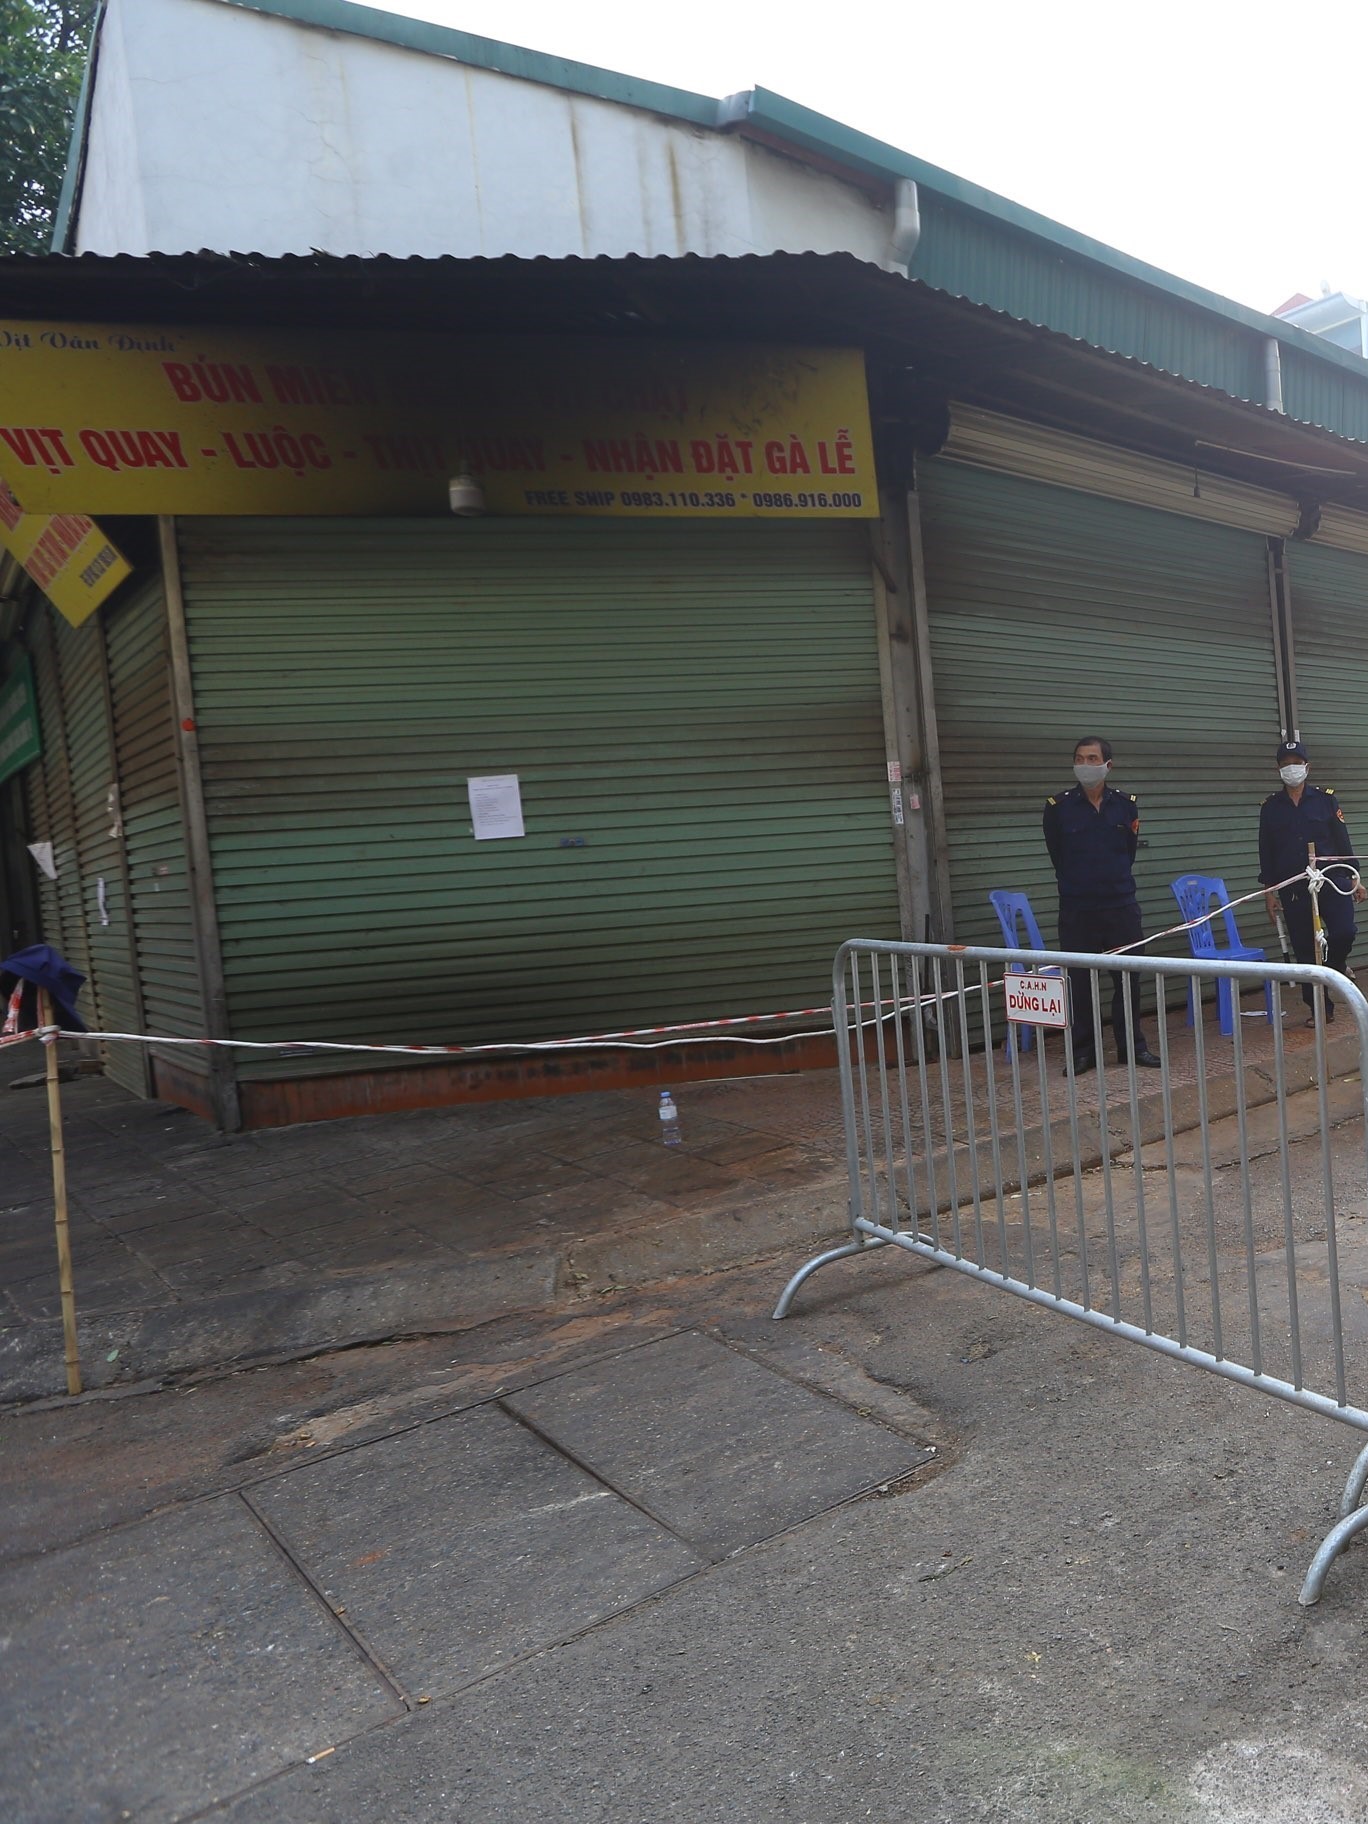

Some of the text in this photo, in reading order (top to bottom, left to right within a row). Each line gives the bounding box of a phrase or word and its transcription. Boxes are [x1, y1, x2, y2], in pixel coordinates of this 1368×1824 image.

[162, 354, 263, 403] BÚN
[0, 428, 75, 474] VỊT
[79, 429, 189, 471] QUAY
[222, 425, 332, 477] LUỘC
[582, 432, 684, 480] NHẬN
[690, 432, 754, 481] ĐẶT
[765, 434, 807, 475] GÀ
[819, 429, 856, 474] LỄ
[524, 490, 569, 505] FREE
[575, 491, 615, 506] SHIP
[621, 491, 736, 508] 0983.110.336
[752, 492, 862, 509] 0986.916.000
[1020, 980, 1047, 991] C.A.H.N
[1009, 990, 1061, 1016] DỪNG LẠI
